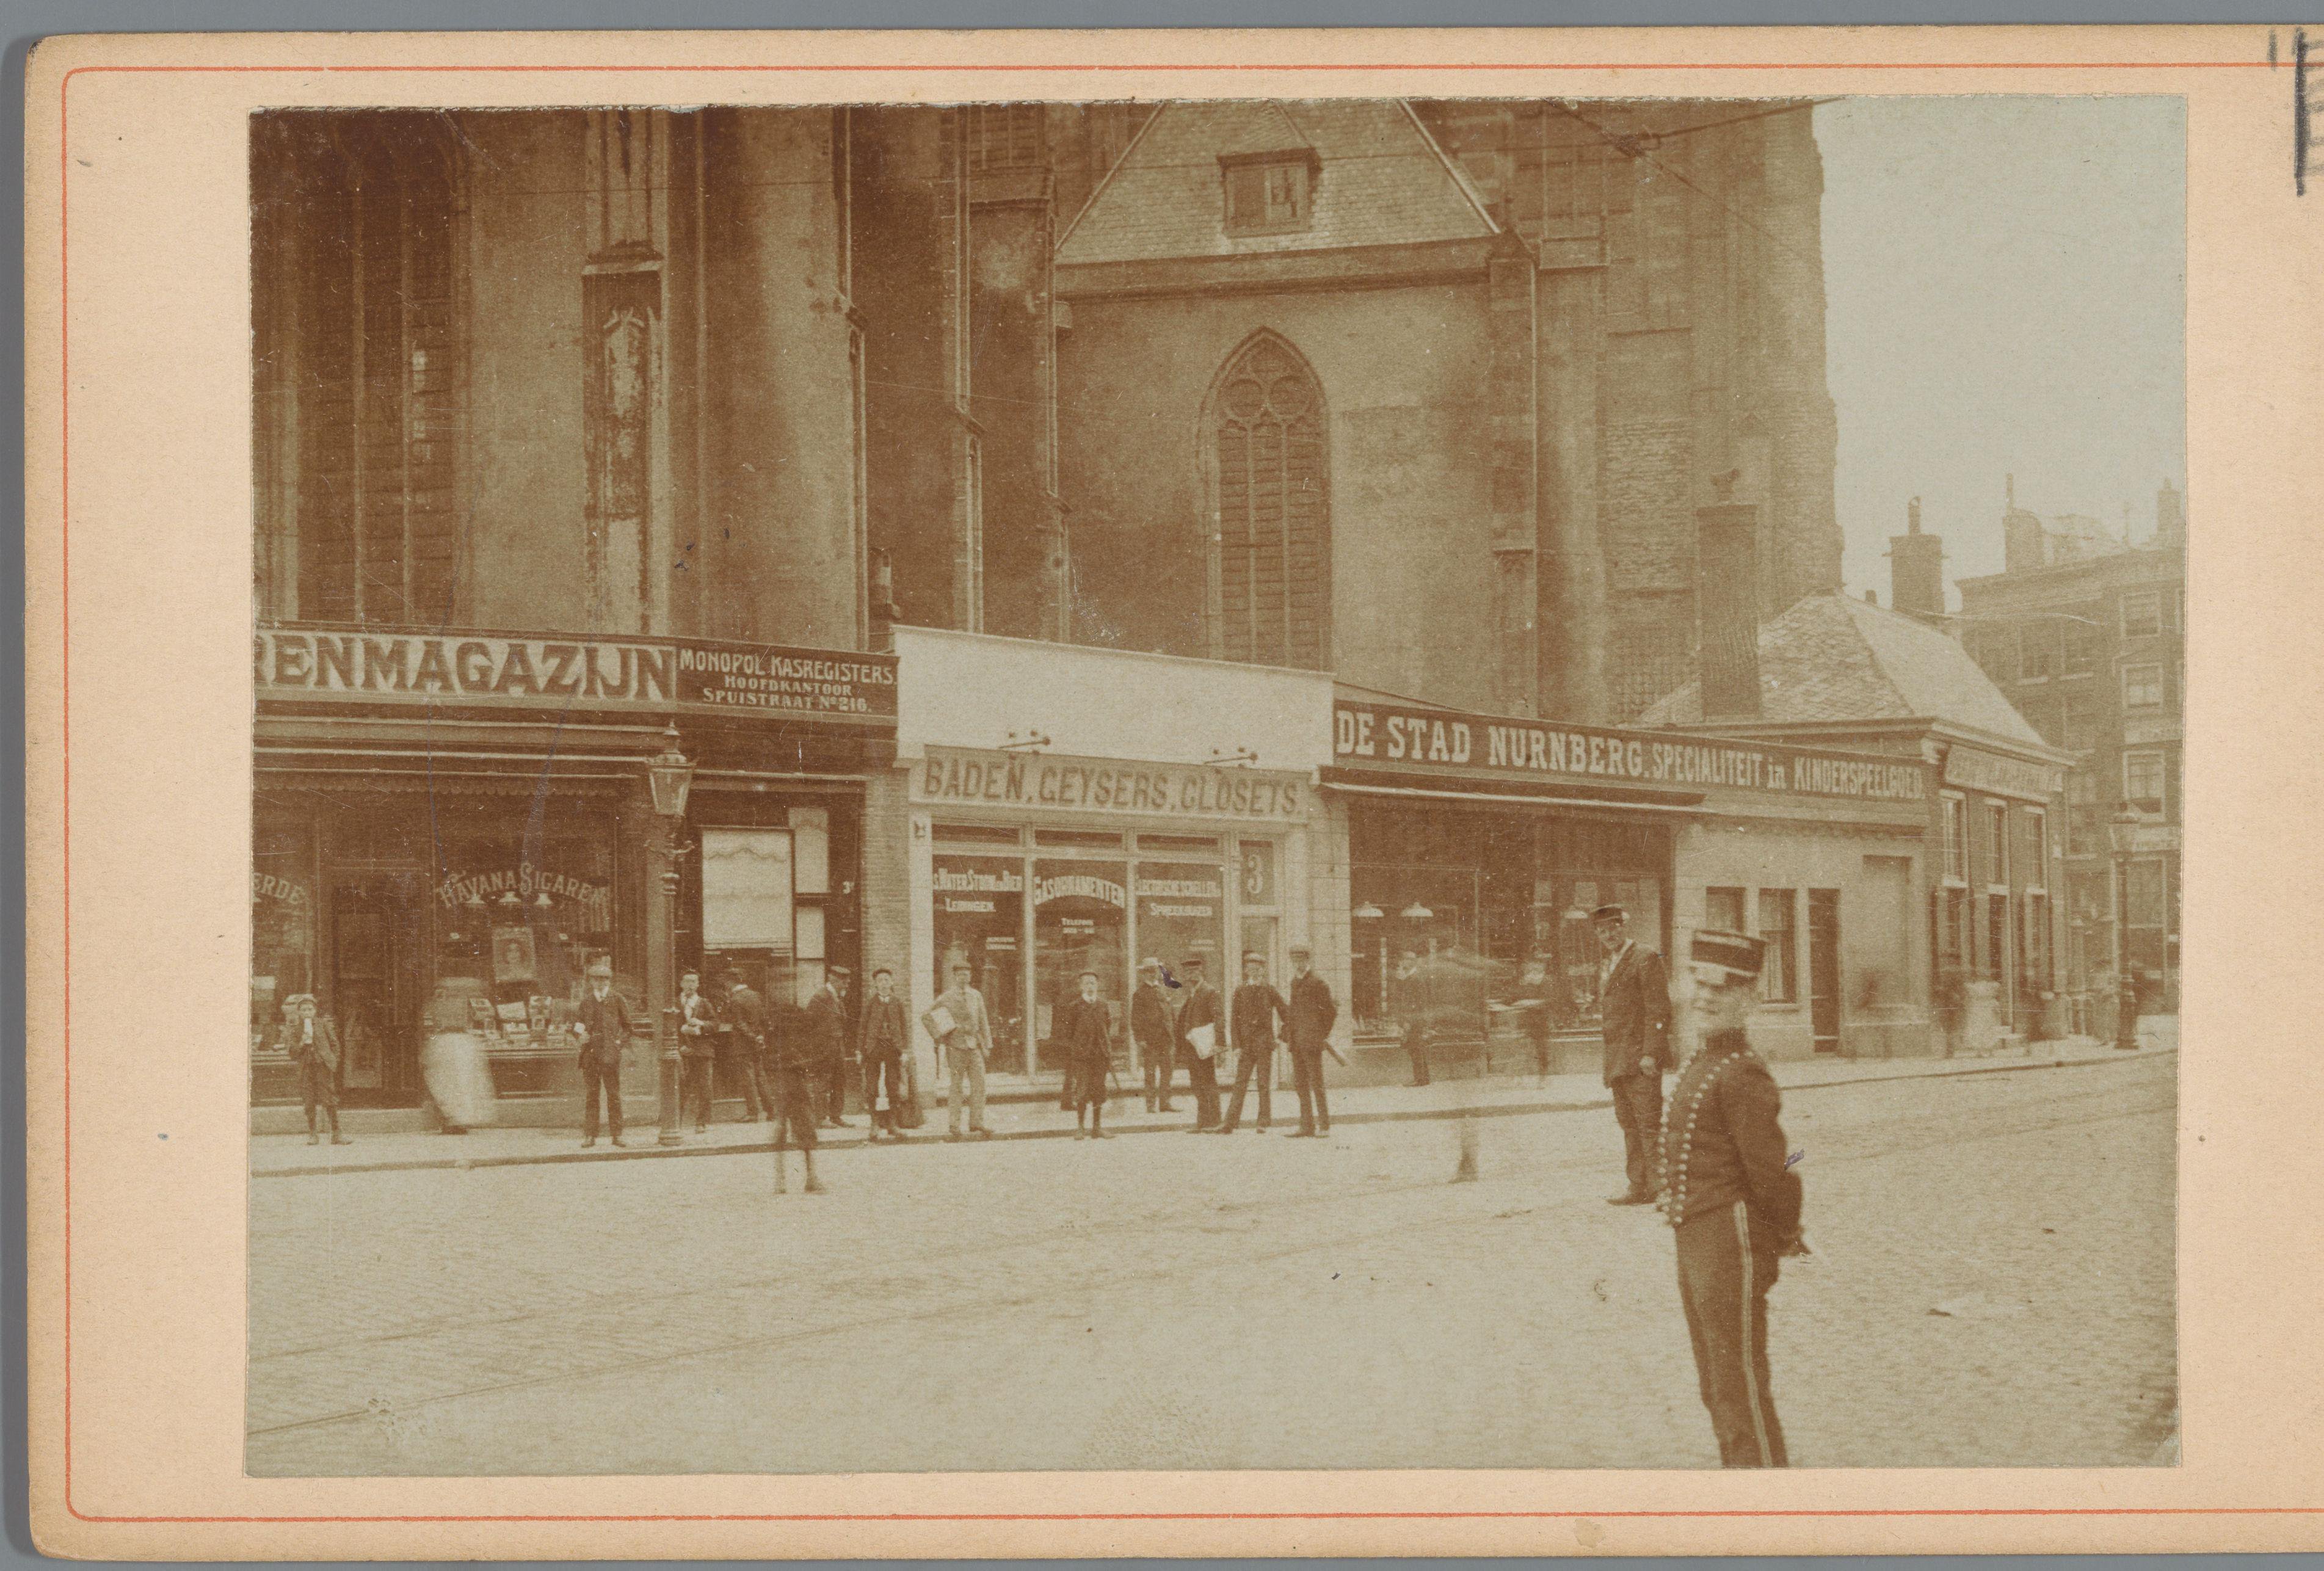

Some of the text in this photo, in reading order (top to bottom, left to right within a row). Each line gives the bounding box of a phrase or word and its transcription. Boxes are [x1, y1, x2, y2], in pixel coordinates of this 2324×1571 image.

[679, 648, 766, 675] MONOPOL
[703, 688, 813, 709] SPUISTRAAT
[724, 675, 852, 696] HOOFDKANTOOR
[1336, 710, 1374, 755] DE
[1387, 716, 1470, 763] STAD
[1652, 743, 1763, 786] SPECIALITEIT
[1247, 854, 1263, 894] 3
